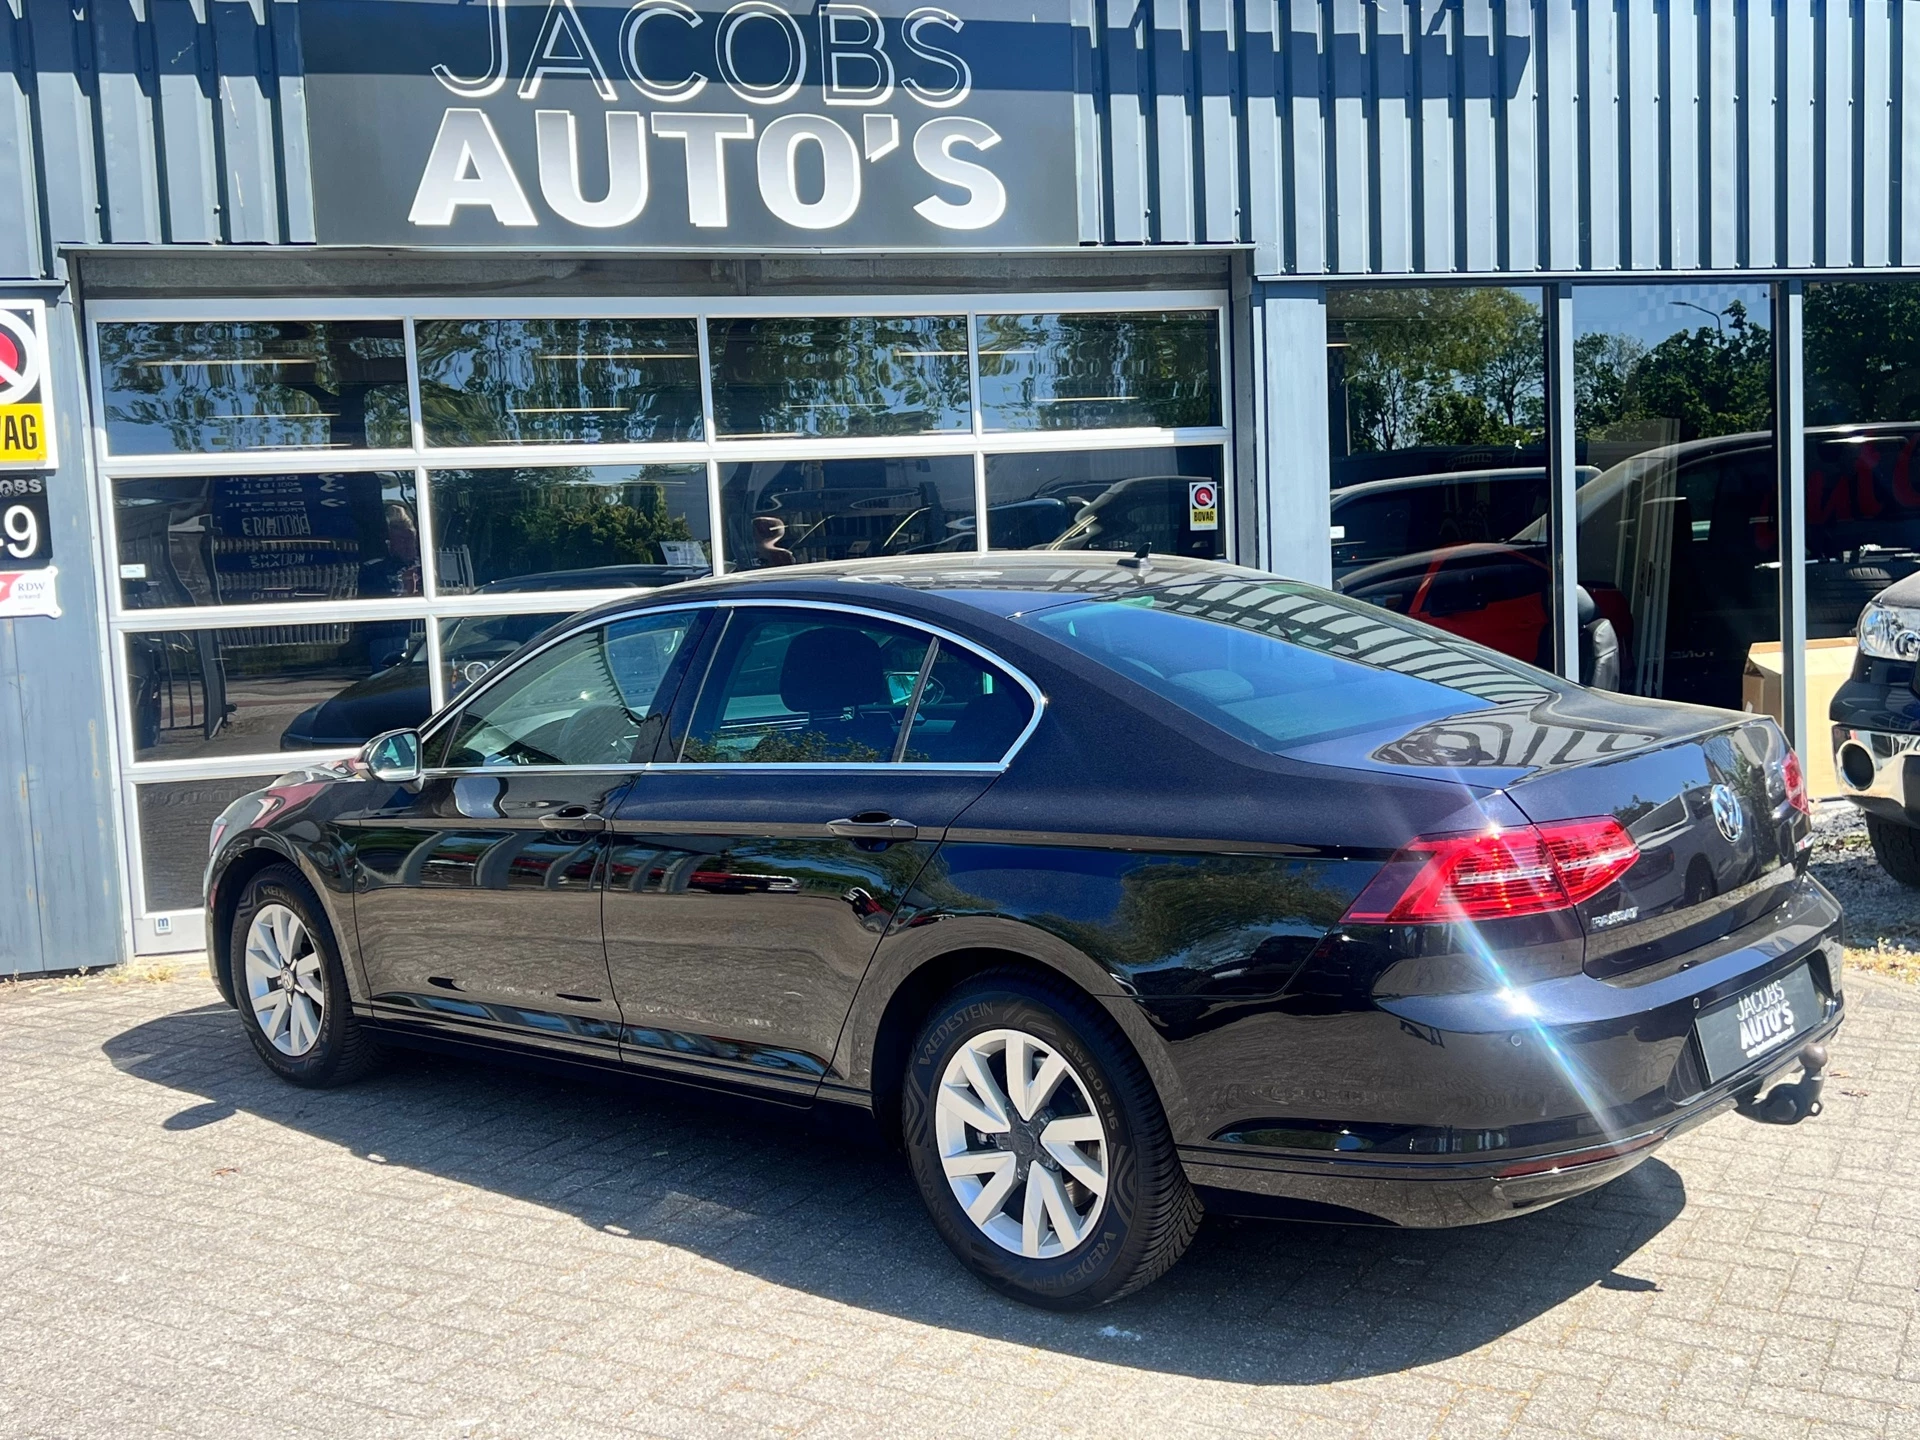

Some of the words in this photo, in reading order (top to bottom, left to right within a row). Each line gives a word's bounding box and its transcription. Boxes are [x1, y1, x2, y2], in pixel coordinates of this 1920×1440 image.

[431, 0, 972, 107] JACOBS
[408, 107, 1006, 229] AUTO'S
[0, 414, 38, 450] AG
[1194, 511, 1214, 522] BOVAG
[18, 582, 45, 592] RDW
[1736, 980, 1785, 1021] JACOBS
[1740, 1000, 1795, 1050] AUTO'S
[918, 1001, 993, 1067] VREDESTEIN
[1066, 1040, 1103, 1091] 215/60
[1107, 1109, 1119, 1130] 16
